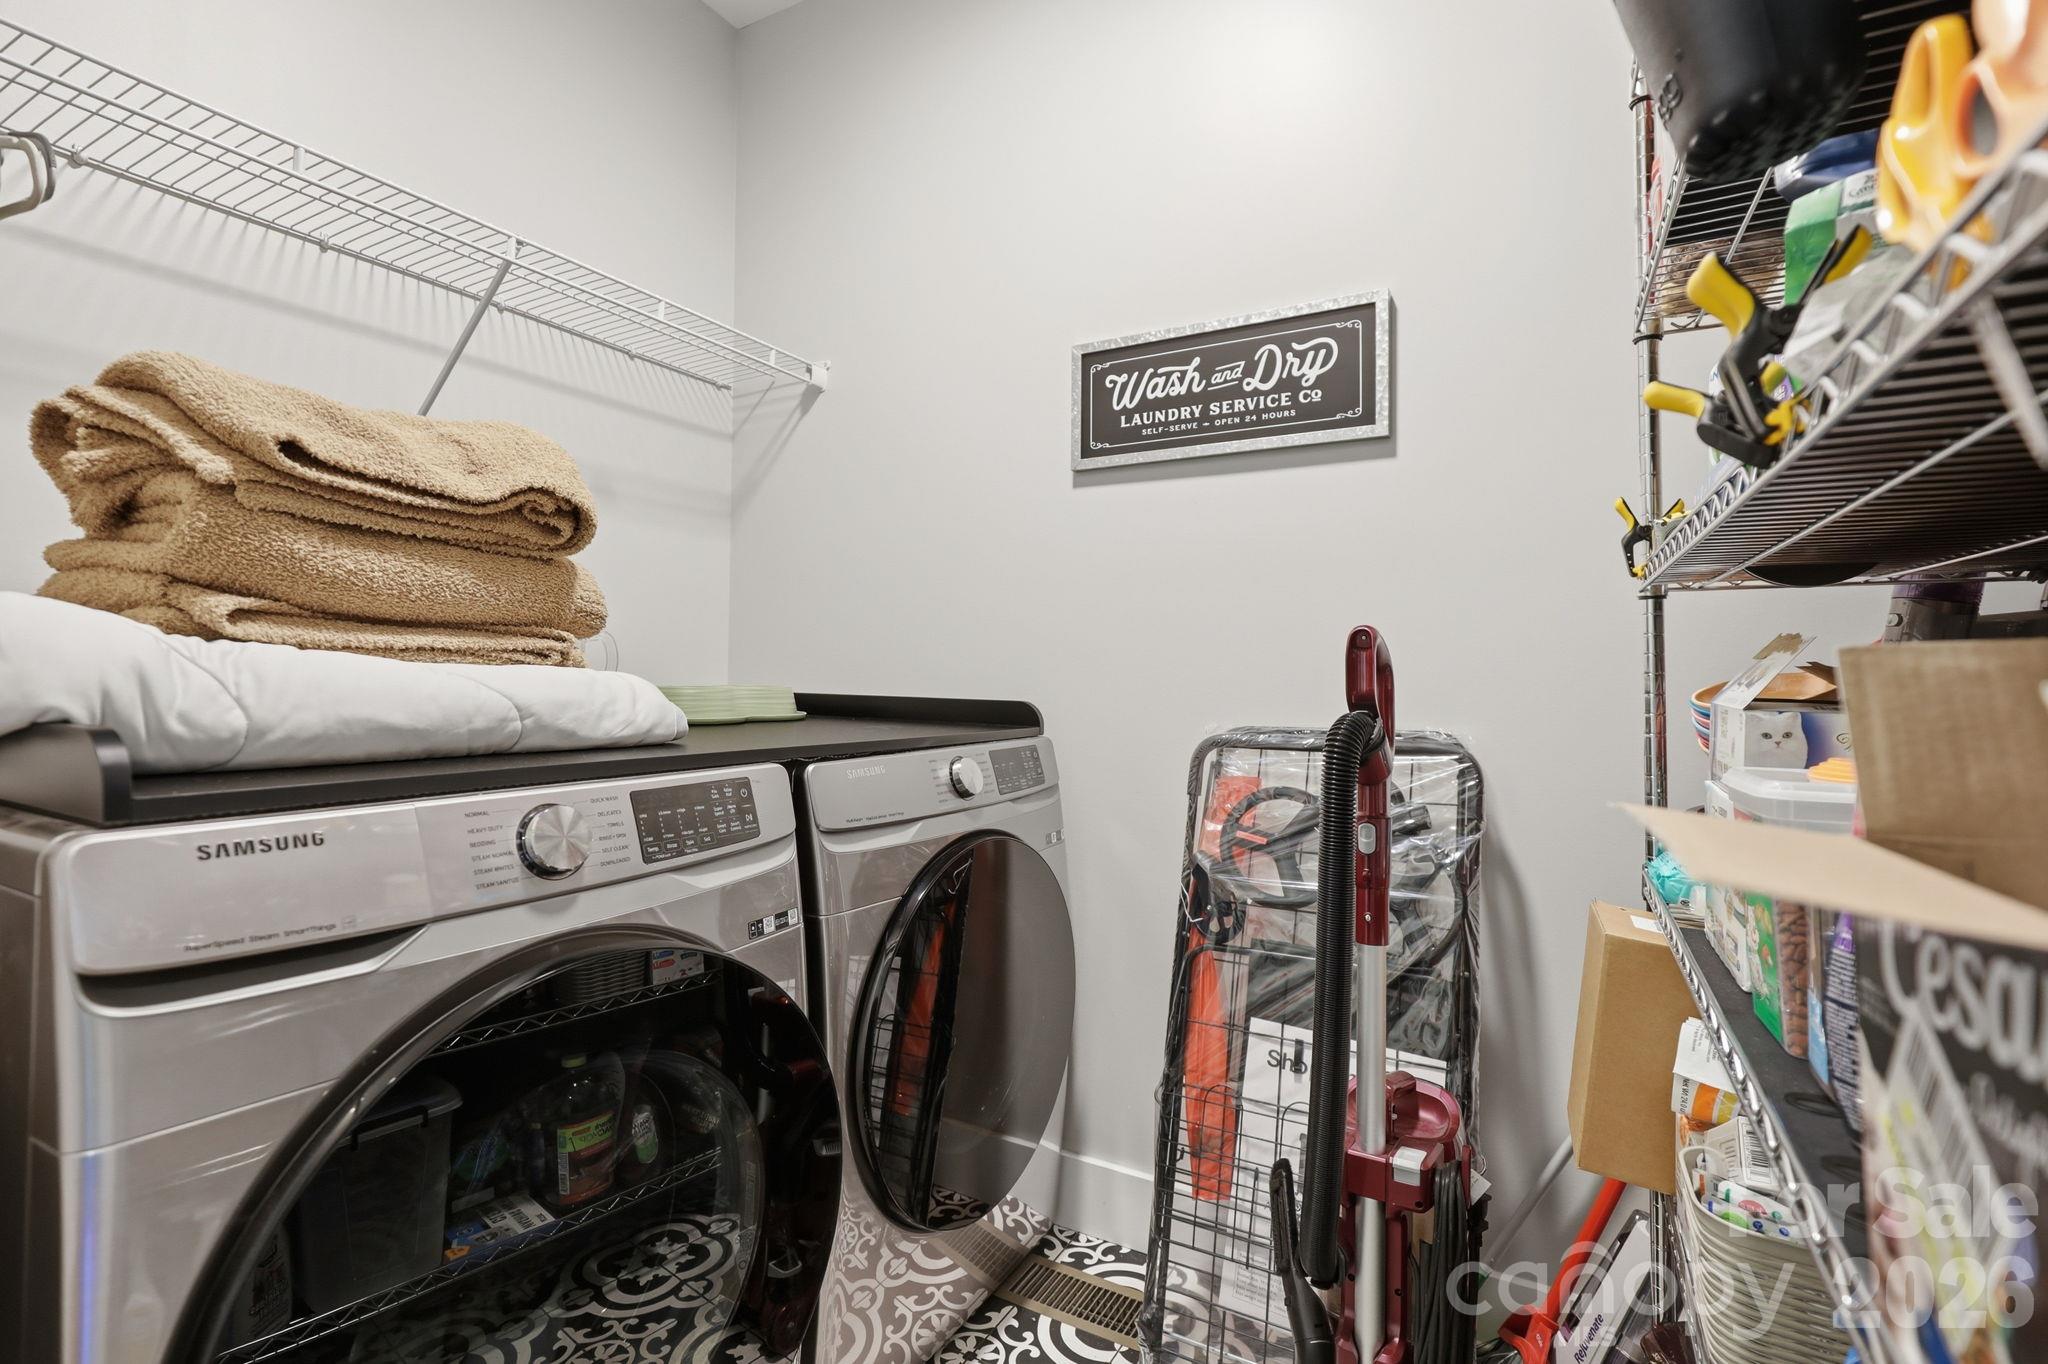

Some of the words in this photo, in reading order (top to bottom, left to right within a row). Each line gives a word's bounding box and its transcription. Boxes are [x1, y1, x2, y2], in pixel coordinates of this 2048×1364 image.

[1105, 356, 1206, 411] Wash
[1210, 361, 1246, 386] and
[1243, 337, 1339, 391] Dry
[1120, 403, 1203, 428] LAUNDRY
[1209, 392, 1292, 416] SERVICE
[1141, 422, 1199, 436] SELF-SERVE
[1214, 416, 1241, 427] OPEN
[1245, 414, 1257, 423] 24
[1262, 409, 1296, 420] HOURS
[846, 764, 886, 780] SAMSUNG
[196, 831, 326, 861] SAMSUNG
[1574, 1313, 1604, 1364] Rejuvenate
